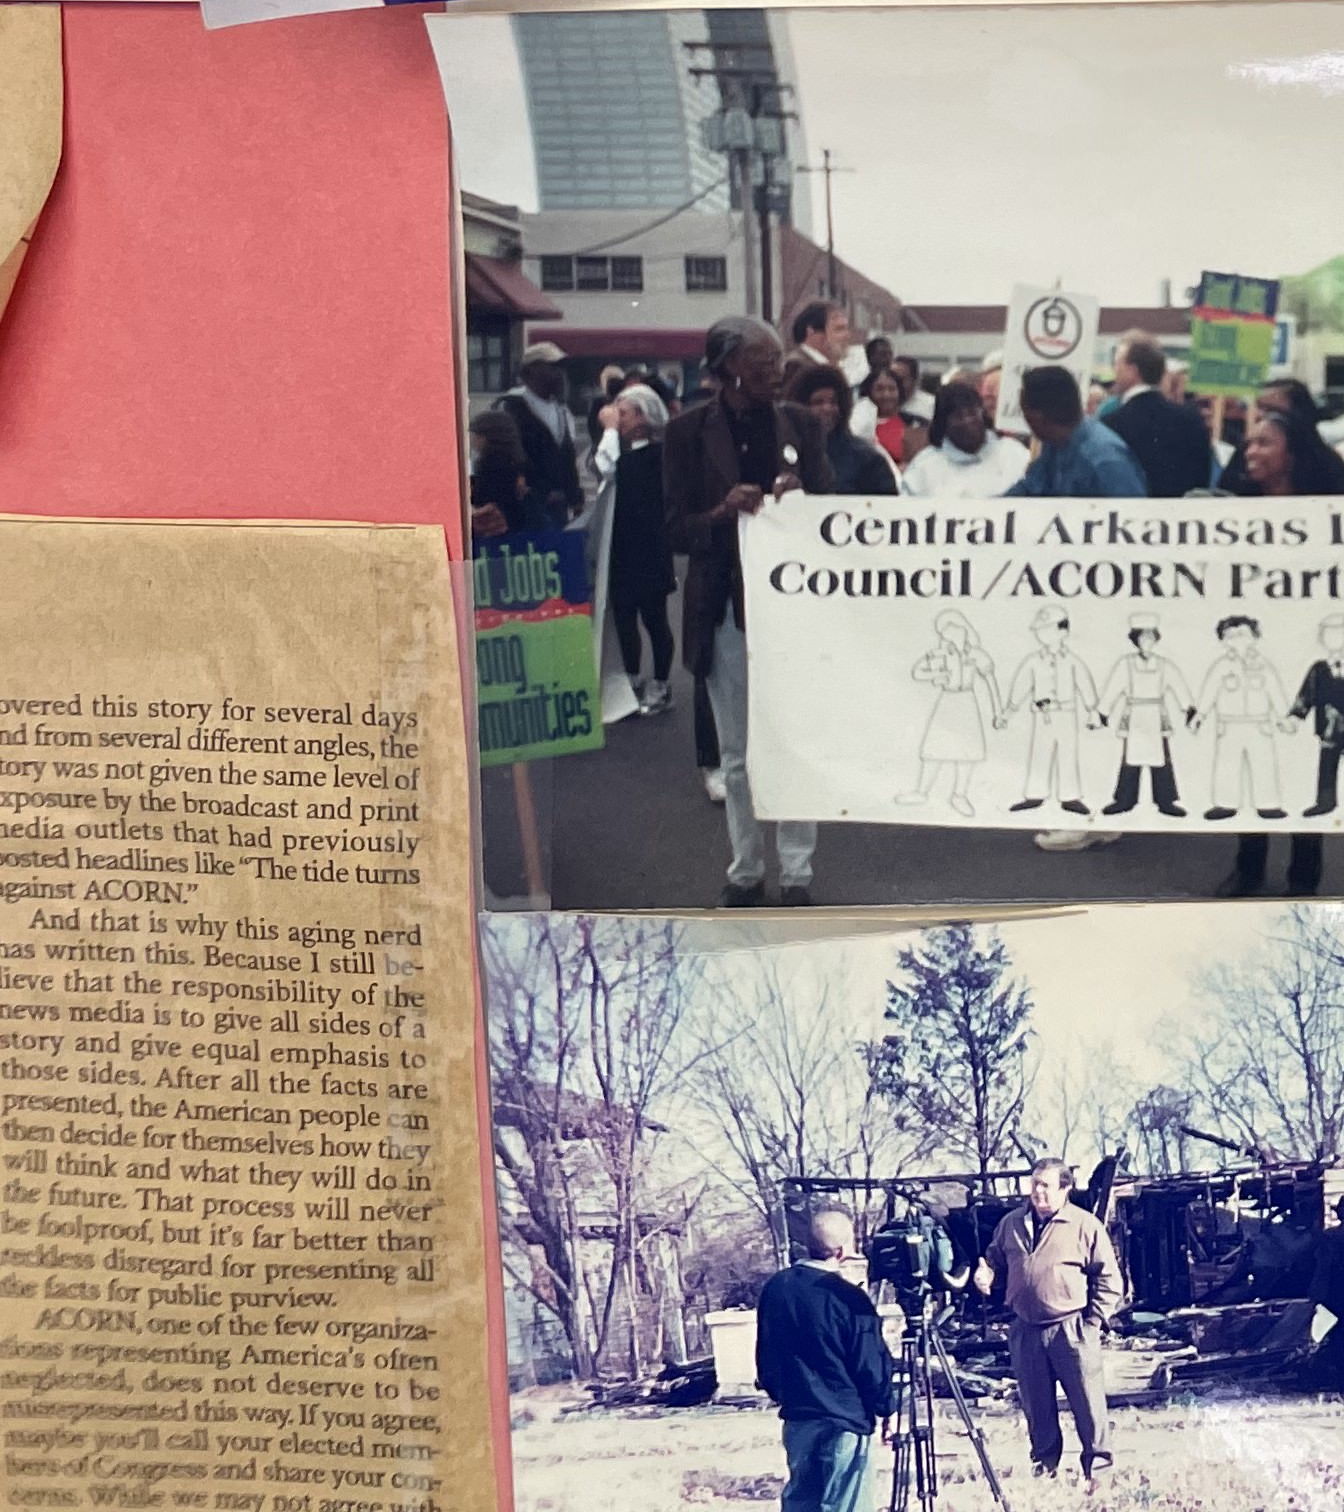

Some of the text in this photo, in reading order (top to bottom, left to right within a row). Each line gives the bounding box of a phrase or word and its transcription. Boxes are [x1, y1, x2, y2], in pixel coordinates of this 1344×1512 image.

[819, 509, 1017, 548] Central
[1037, 510, 1309, 547] Arkansas
[500, 541, 563, 605] Jobs
[92, 696, 137, 717] this
[147, 699, 212, 724] story
[222, 699, 255, 722] for
[264, 704, 352, 725] several
[362, 706, 418, 731] days
[34, 725, 92, 747] from
[99, 726, 181, 750] several
[187, 728, 288, 755] different
[293, 737, 375, 761] angles,
[381, 736, 418, 758] the
[53, 761, 98, 778] was
[105, 763, 145, 780] not
[150, 762, 212, 786] given
[219, 762, 257, 785] the
[262, 768, 326, 786] same
[333, 766, 387, 788] level
[395, 768, 420, 790] of
[104, 789, 131, 815] by
[139, 791, 176, 812] the
[184, 794, 299, 819] broadcast
[306, 796, 352, 819] and
[360, 801, 419, 826] print
[75, 820, 162, 841] outlets
[173, 822, 219, 844] that
[228, 825, 271, 848] had
[282, 829, 420, 856] previously
[76, 847, 188, 873] headlines
[195, 850, 235, 875] like
[303, 860, 348, 882] tide
[355, 864, 420, 885] turns
[28, 907, 422, 949] And that is why this aging nerd
[45, 938, 135, 963] written
[145, 941, 195, 965] this.
[204, 945, 301, 972] Because
[311, 951, 319, 972] I
[329, 952, 375, 974] still
[63, 968, 113, 992] that
[124, 970, 161, 993] the
[171, 977, 342, 1008] responsibility
[351, 984, 378, 1005] of
[384, 986, 425, 1008] the
[0, 999, 425, 1039] news media is to give all sides of a
[0, 1030, 426, 1069] story and give equal emphasis to
[1, 1061, 428, 1101] those sides. After all the facts are
[2, 1093, 124, 1117] presented,
[130, 1095, 167, 1117] the
[174, 1098, 290, 1124] American
[299, 1103, 380, 1131] people
[182, 1127, 314, 1156] themselves
[201, 1192, 295, 1219] process
[293, 1225, 432, 1251] better than
[264, 1257, 397, 1285] presenting
[148, 1281, 337, 1312] public purview.
[325, 1319, 437, 1349] organiza-
[241, 1345, 437, 1370] America's often
[371, 1412, 441, 1435] agree,
[279, 1433, 363, 1457] elected
